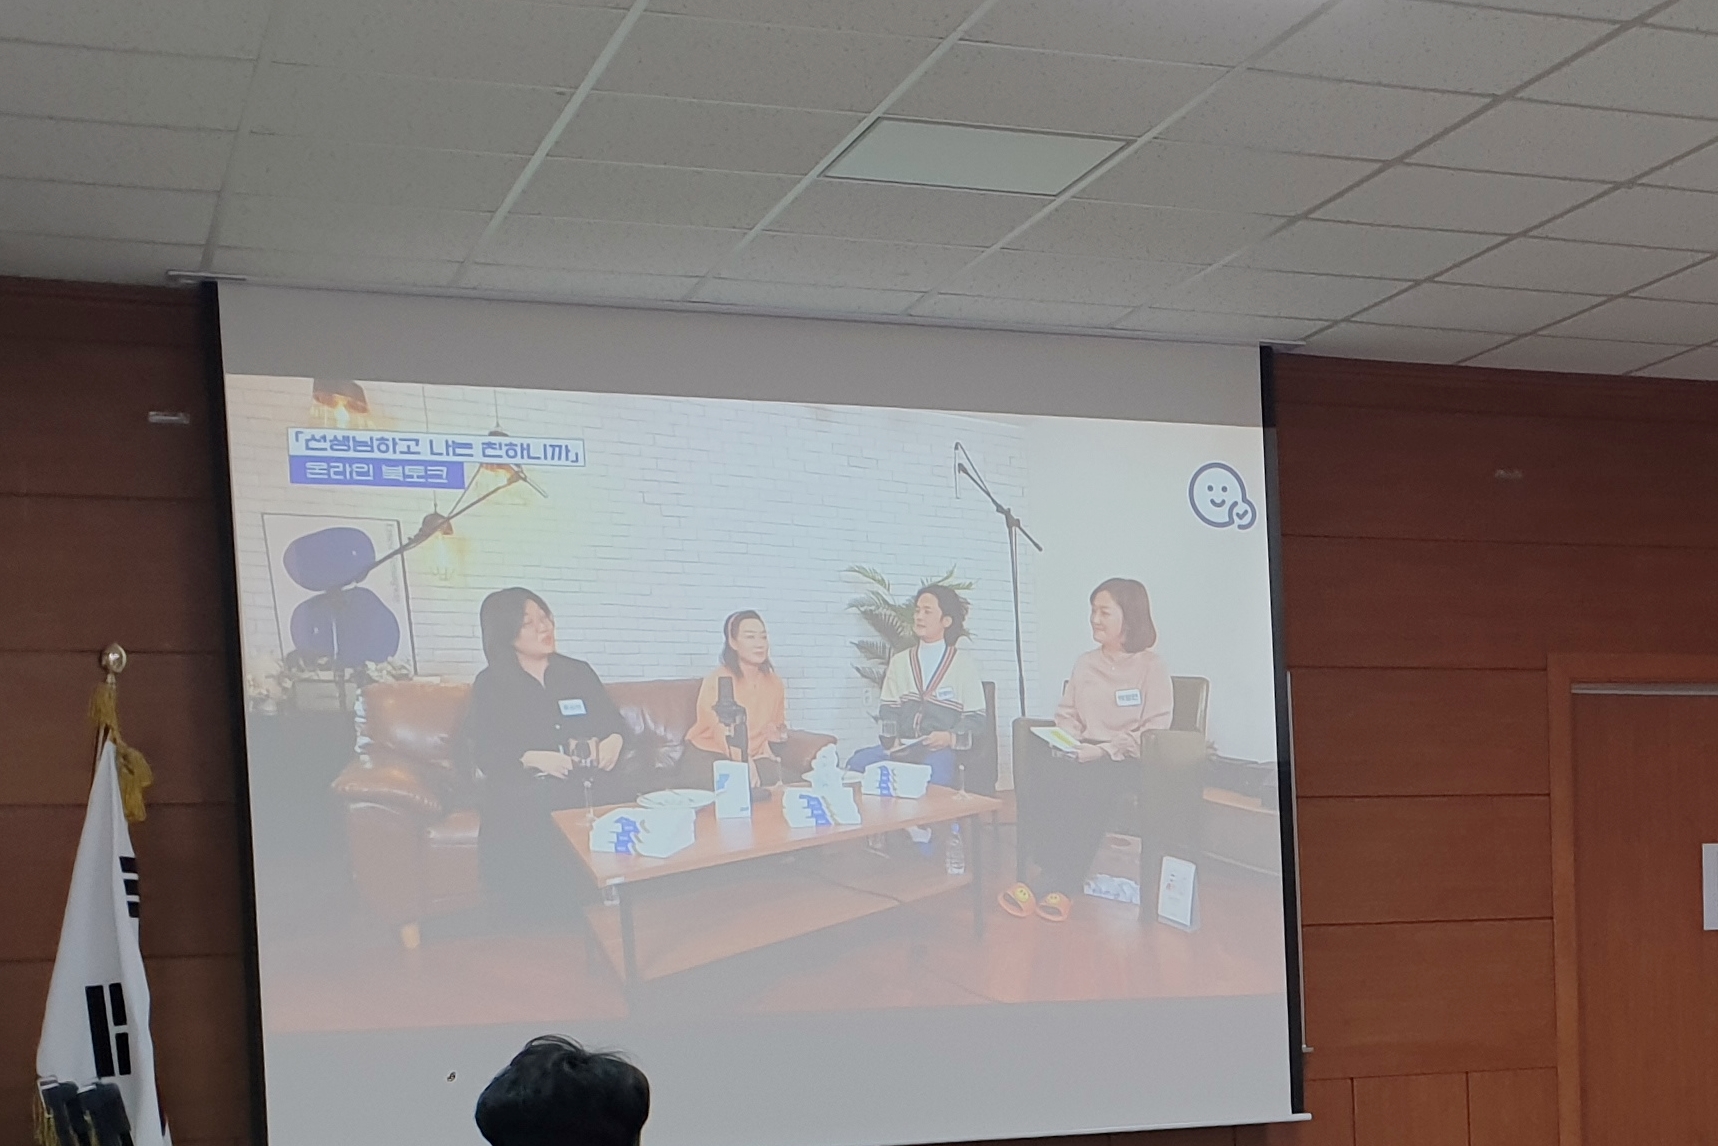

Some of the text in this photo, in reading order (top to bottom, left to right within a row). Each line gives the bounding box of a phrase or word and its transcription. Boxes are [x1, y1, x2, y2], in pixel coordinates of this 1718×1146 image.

[429, 439, 474, 458] 나는
[305, 462, 448, 483] 온라인 북토크
